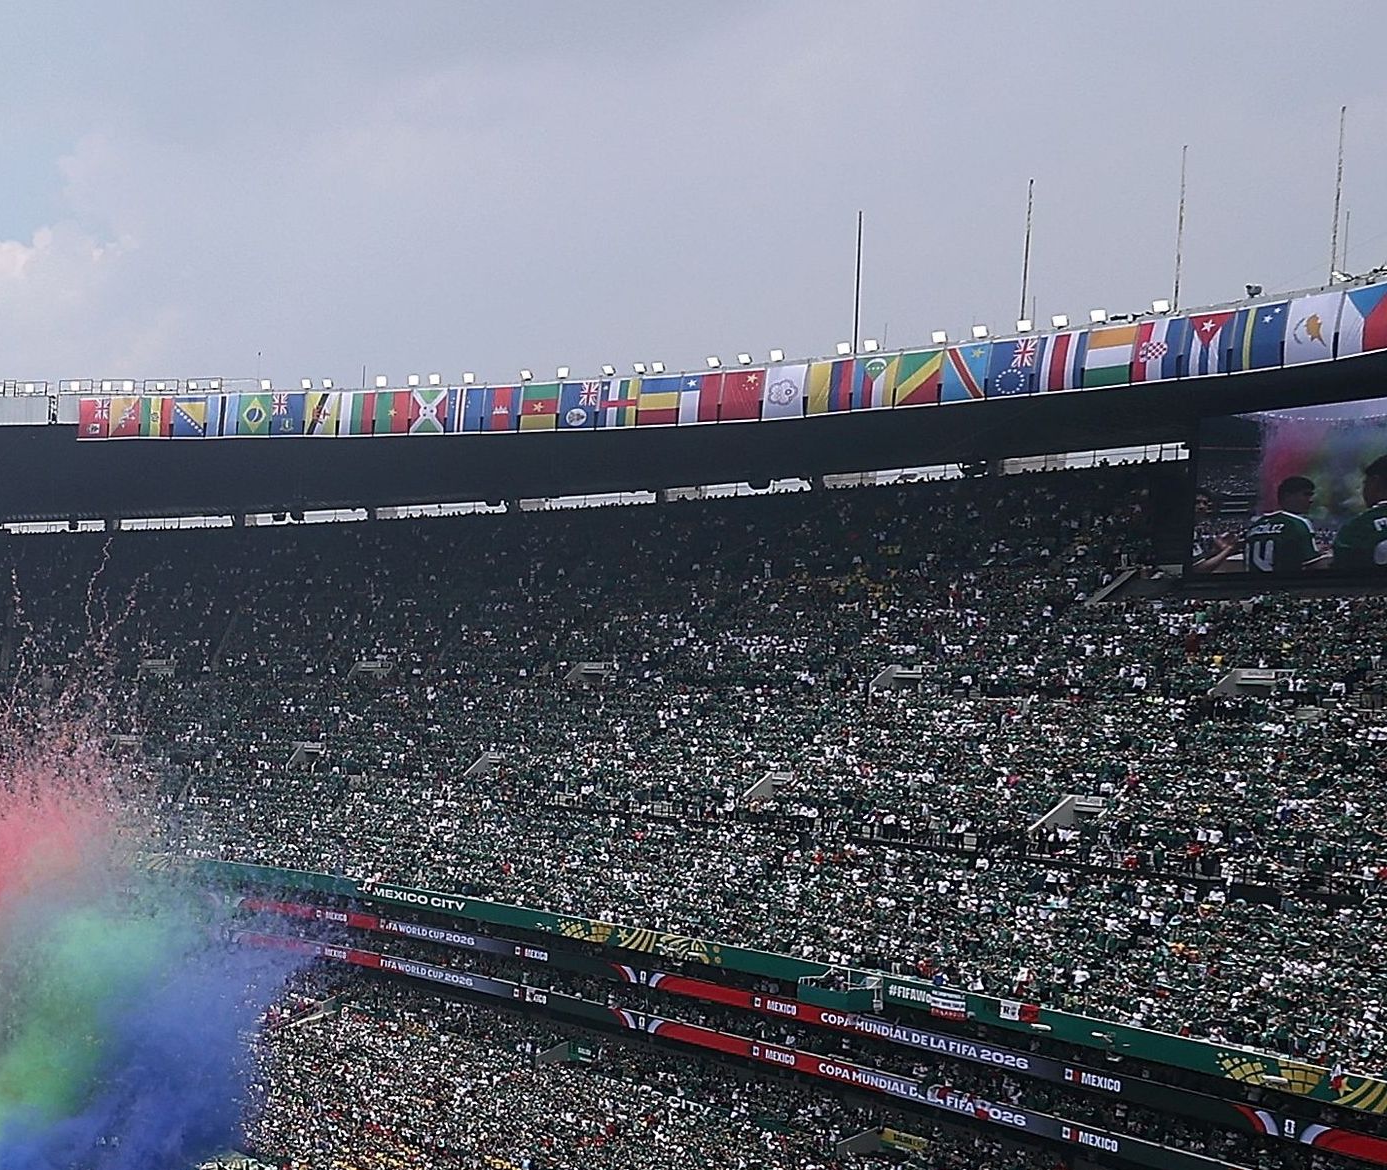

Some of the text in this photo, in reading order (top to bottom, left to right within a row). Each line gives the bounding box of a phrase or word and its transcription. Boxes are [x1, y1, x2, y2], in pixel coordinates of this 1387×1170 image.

[373, 886, 466, 912] MEXICO CITY
[399, 923, 475, 946] WORLD CUP 2026
[524, 948, 549, 962] MEXICO
[380, 959, 474, 986] FIFA WORLD CUP 2026
[767, 999, 797, 1016] MEXICO
[854, 1016, 910, 1044] MUNDIAL
[911, 1033, 928, 1047] DE
[927, 1037, 948, 1052] LA
[948, 1041, 978, 1060] FIFA
[980, 1050, 1029, 1070] 2026
[765, 1048, 796, 1066] MEXICO
[818, 1063, 850, 1082] COPA
[851, 1069, 908, 1097] MUNDIAL
[945, 1094, 975, 1114] FIFA
[1080, 1073, 1121, 1093] MEXICO
[666, 1095, 711, 1116] CITY
[1078, 1131, 1119, 1153] MEXICO
